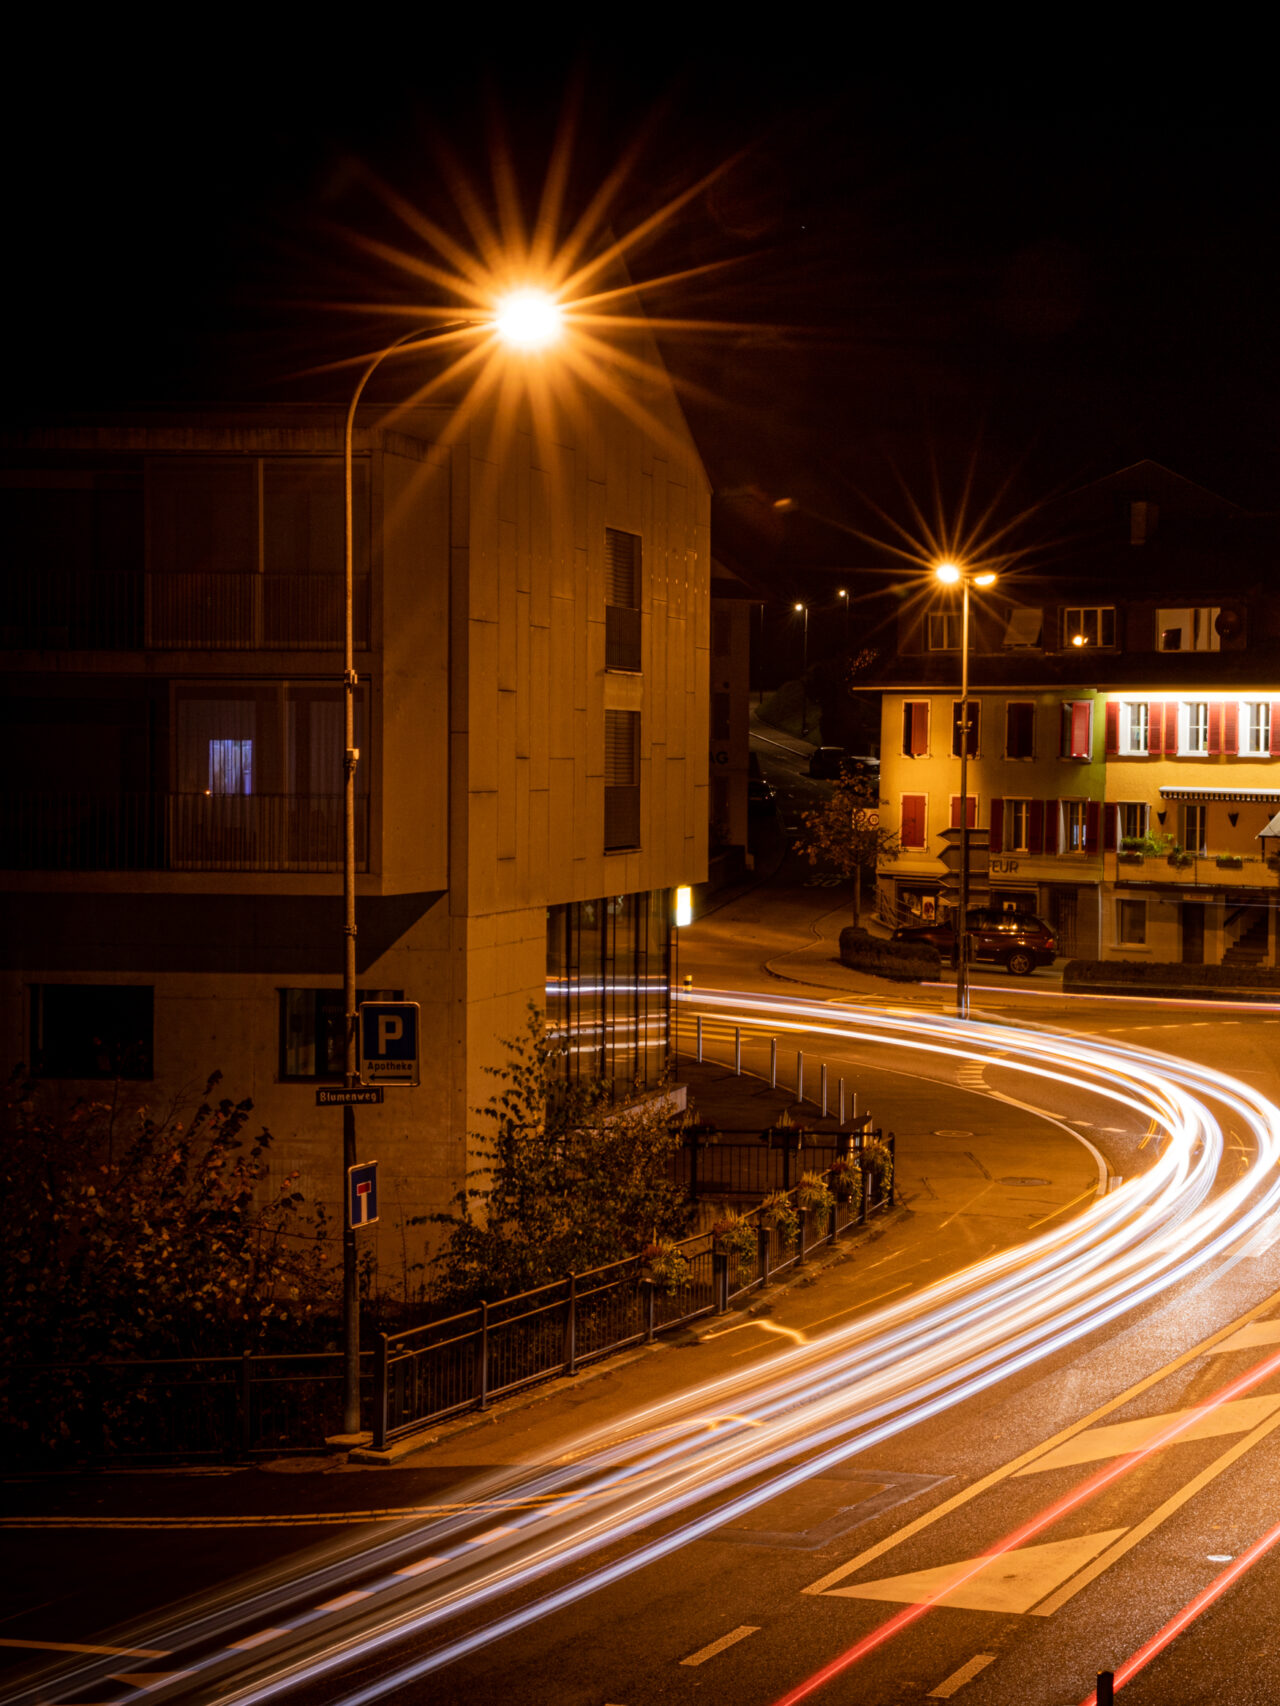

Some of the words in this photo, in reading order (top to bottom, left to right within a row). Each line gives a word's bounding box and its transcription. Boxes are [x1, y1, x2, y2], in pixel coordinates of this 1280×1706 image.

[989, 860, 1019, 873] EUR
[378, 1014, 404, 1055] P
[367, 1061, 413, 1072] Apotheke
[319, 1091, 378, 1103] Blumenweg
